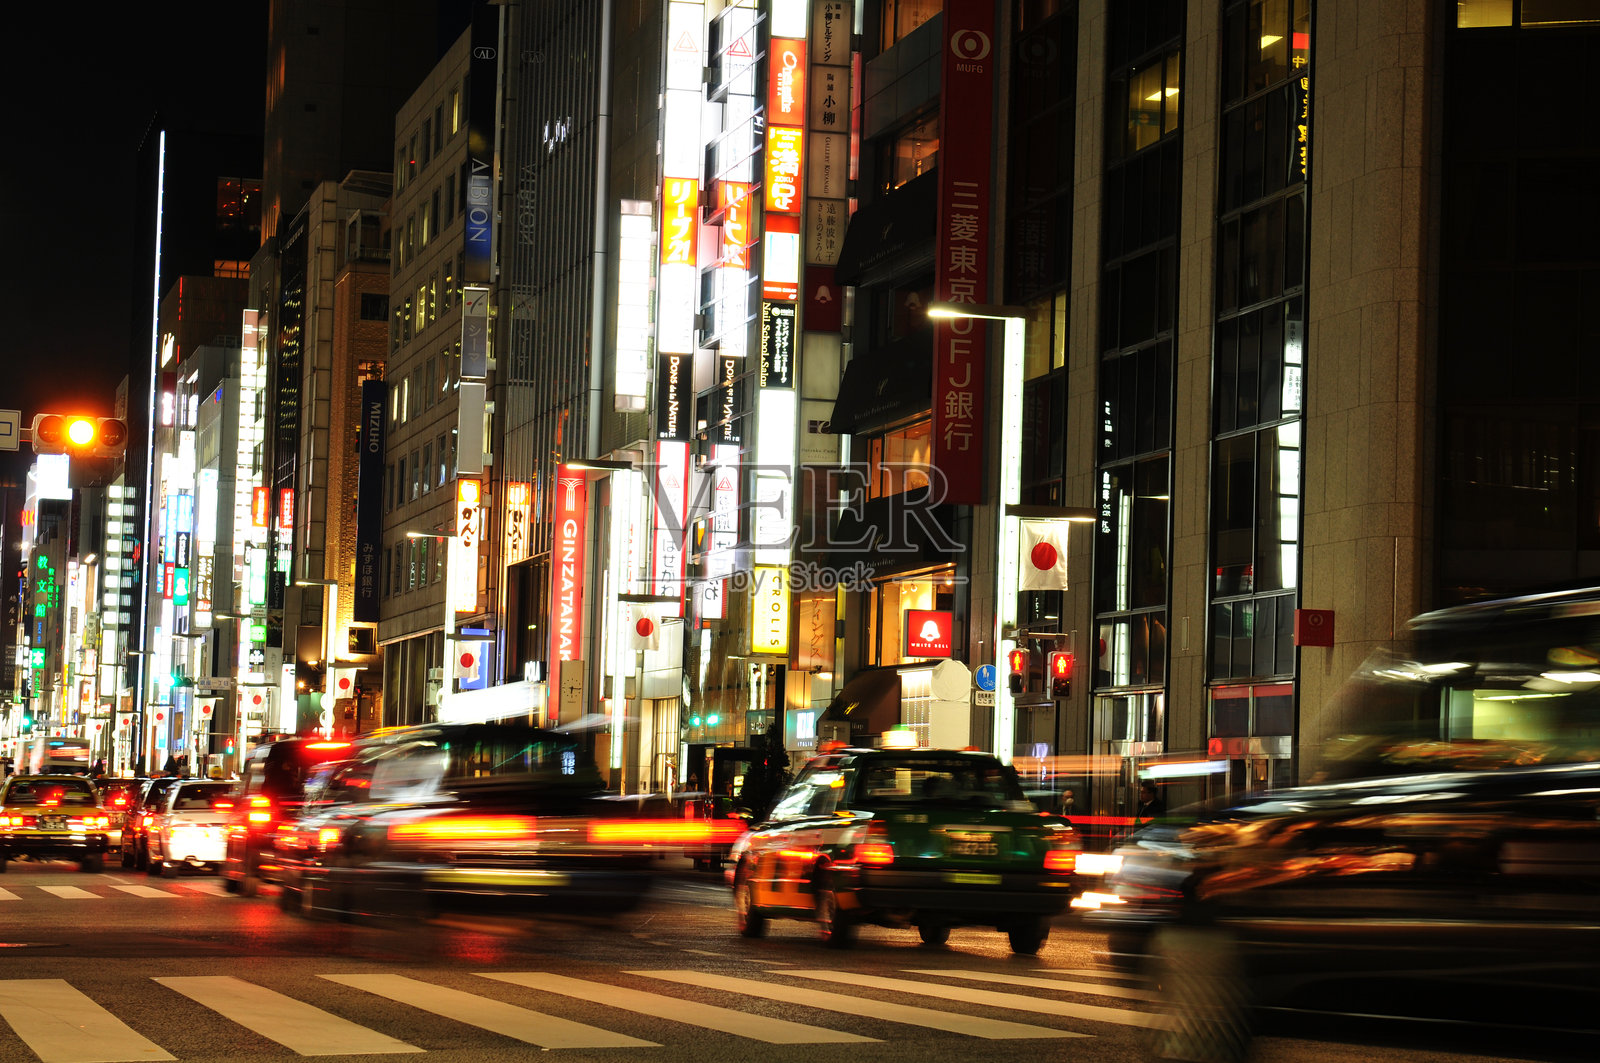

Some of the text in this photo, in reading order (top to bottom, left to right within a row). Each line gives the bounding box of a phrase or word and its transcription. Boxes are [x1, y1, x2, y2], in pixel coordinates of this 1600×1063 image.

[956, 63, 984, 73] MUFG
[823, 96, 836, 126] 小柳
[824, 136, 832, 163] GALLERY
[469, 157, 490, 243] ALBION
[944, 180, 979, 453] 三菱東京UFJ銀行
[368, 401, 381, 454] MIZUHO
[668, 400, 679, 438] NATURE
[35, 554, 49, 618] 教文館
[361, 542, 374, 599] みずほ銀行
